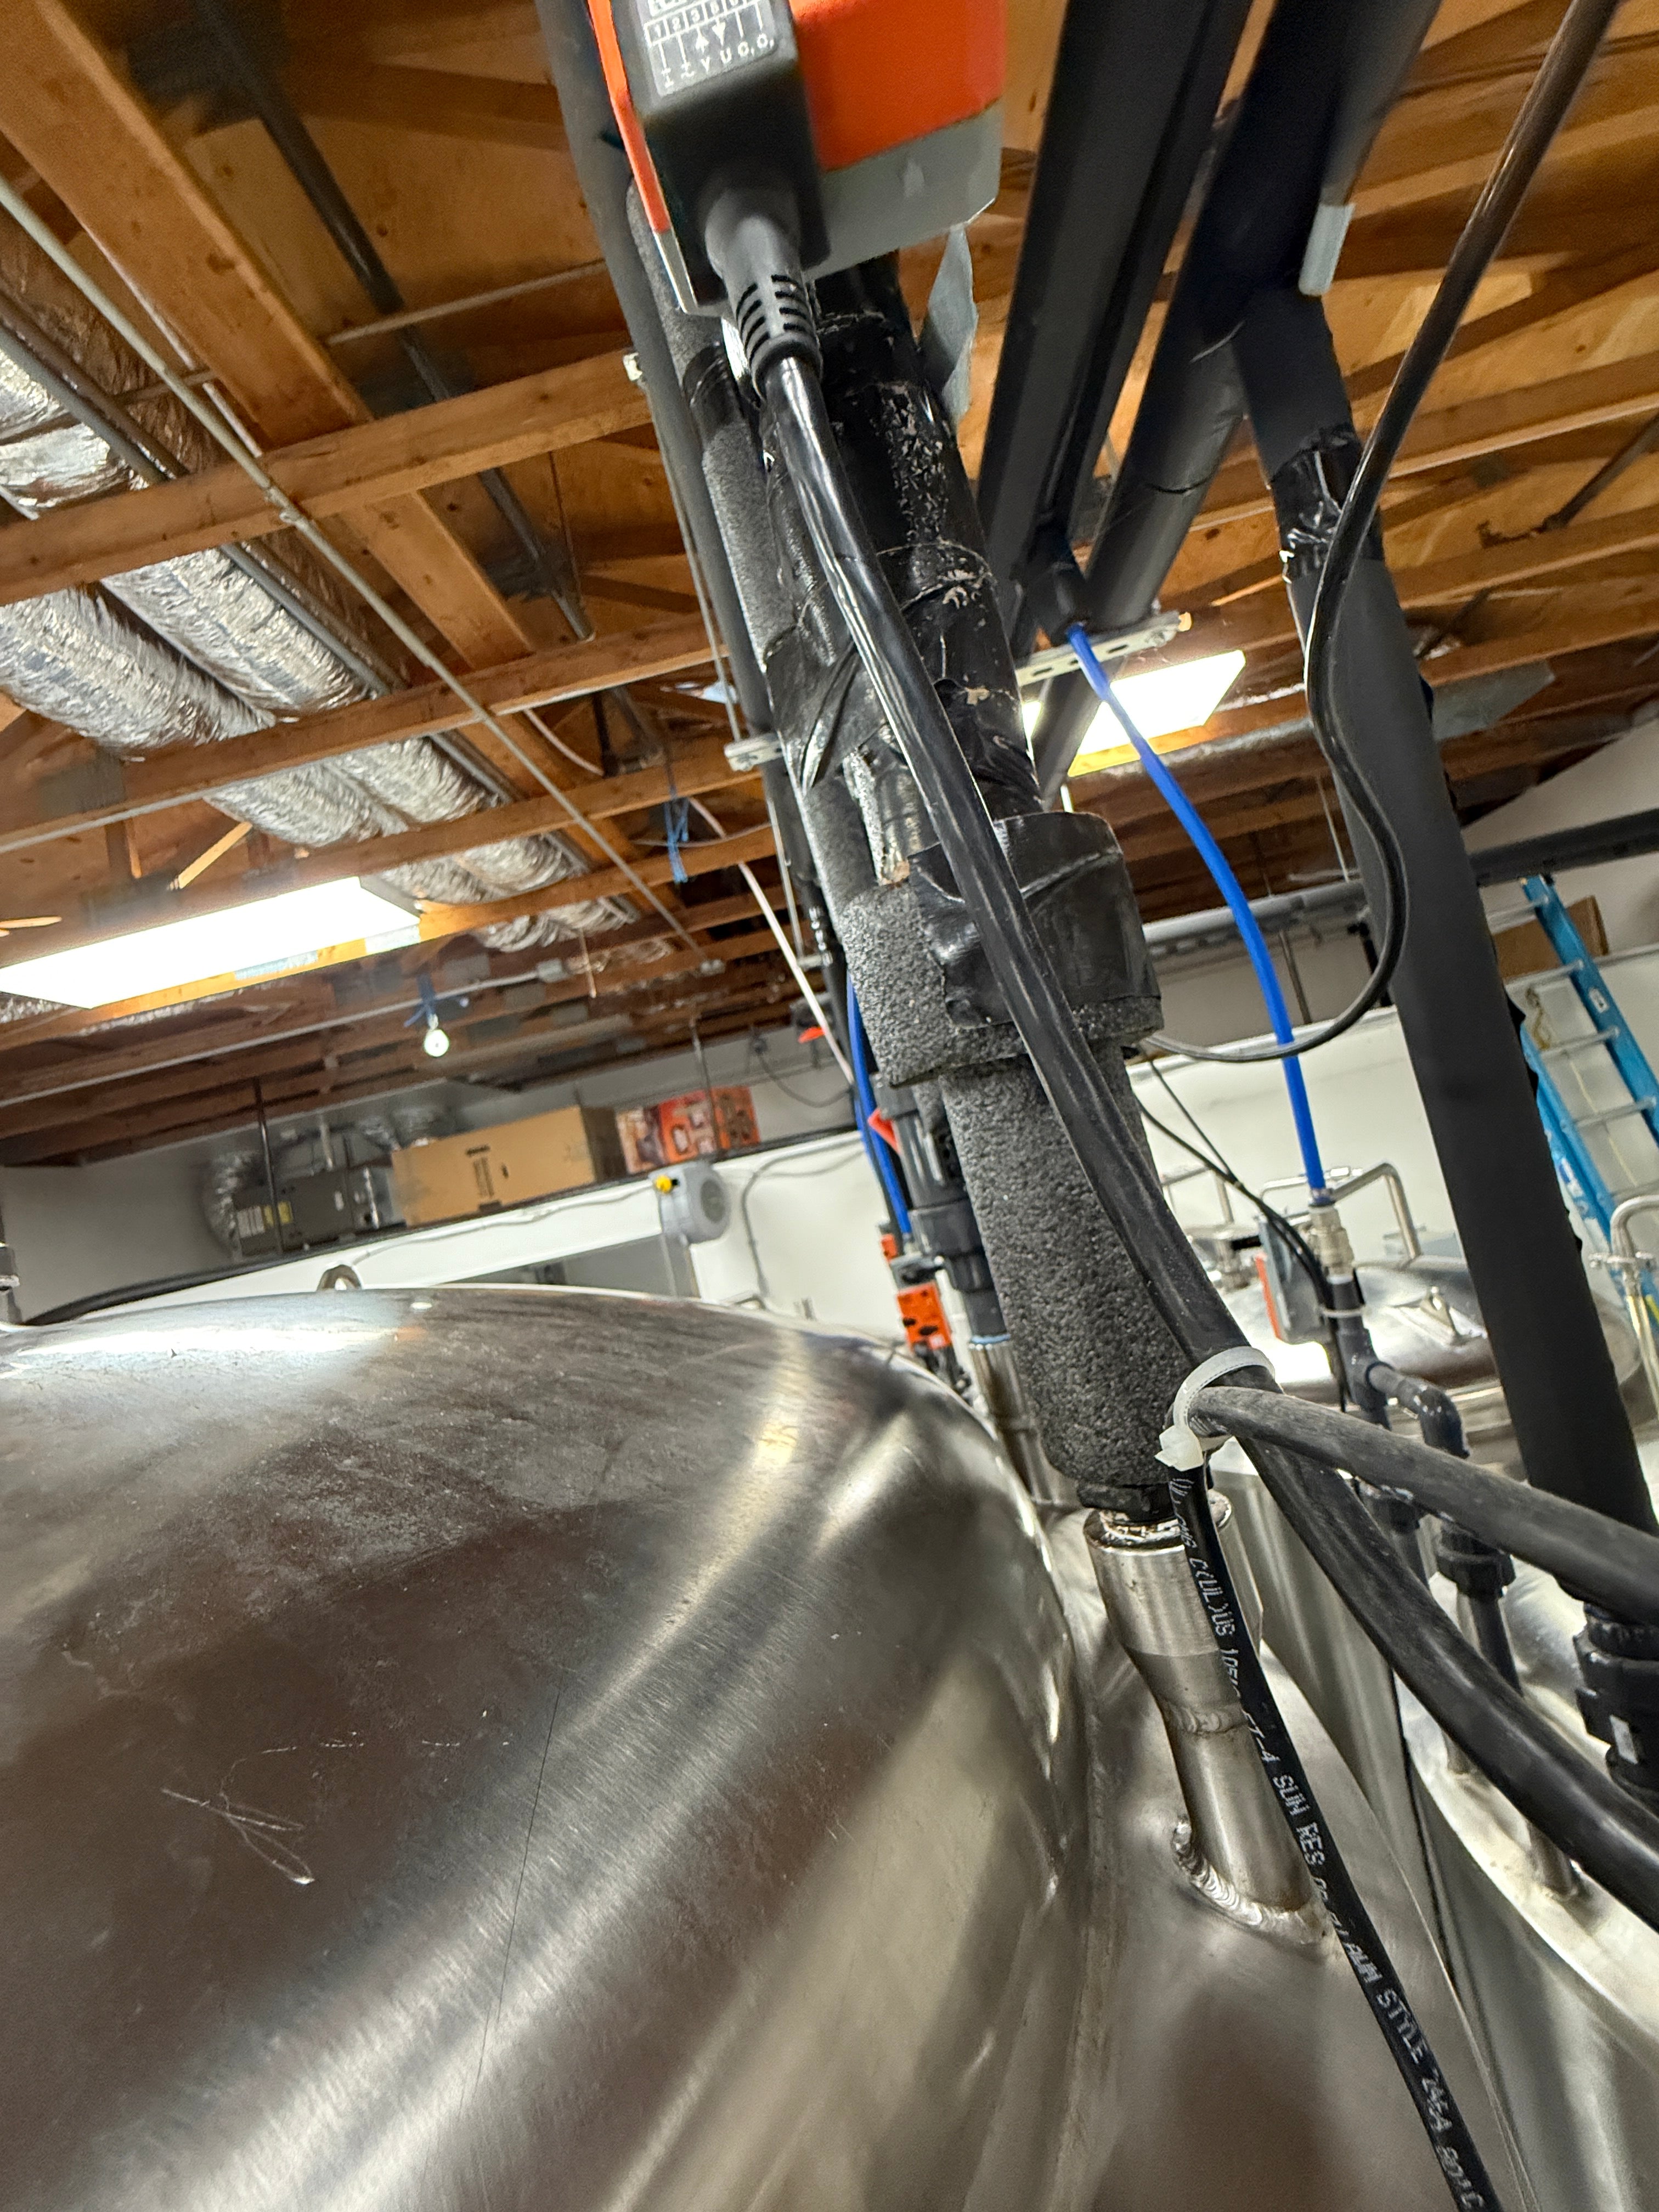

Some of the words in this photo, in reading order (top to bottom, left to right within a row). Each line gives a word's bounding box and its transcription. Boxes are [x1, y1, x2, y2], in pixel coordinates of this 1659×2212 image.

[1273, 1774, 1311, 1816] SUN
[1295, 1821, 1325, 1866] RES
[1376, 1988, 1426, 2066] STYLE
